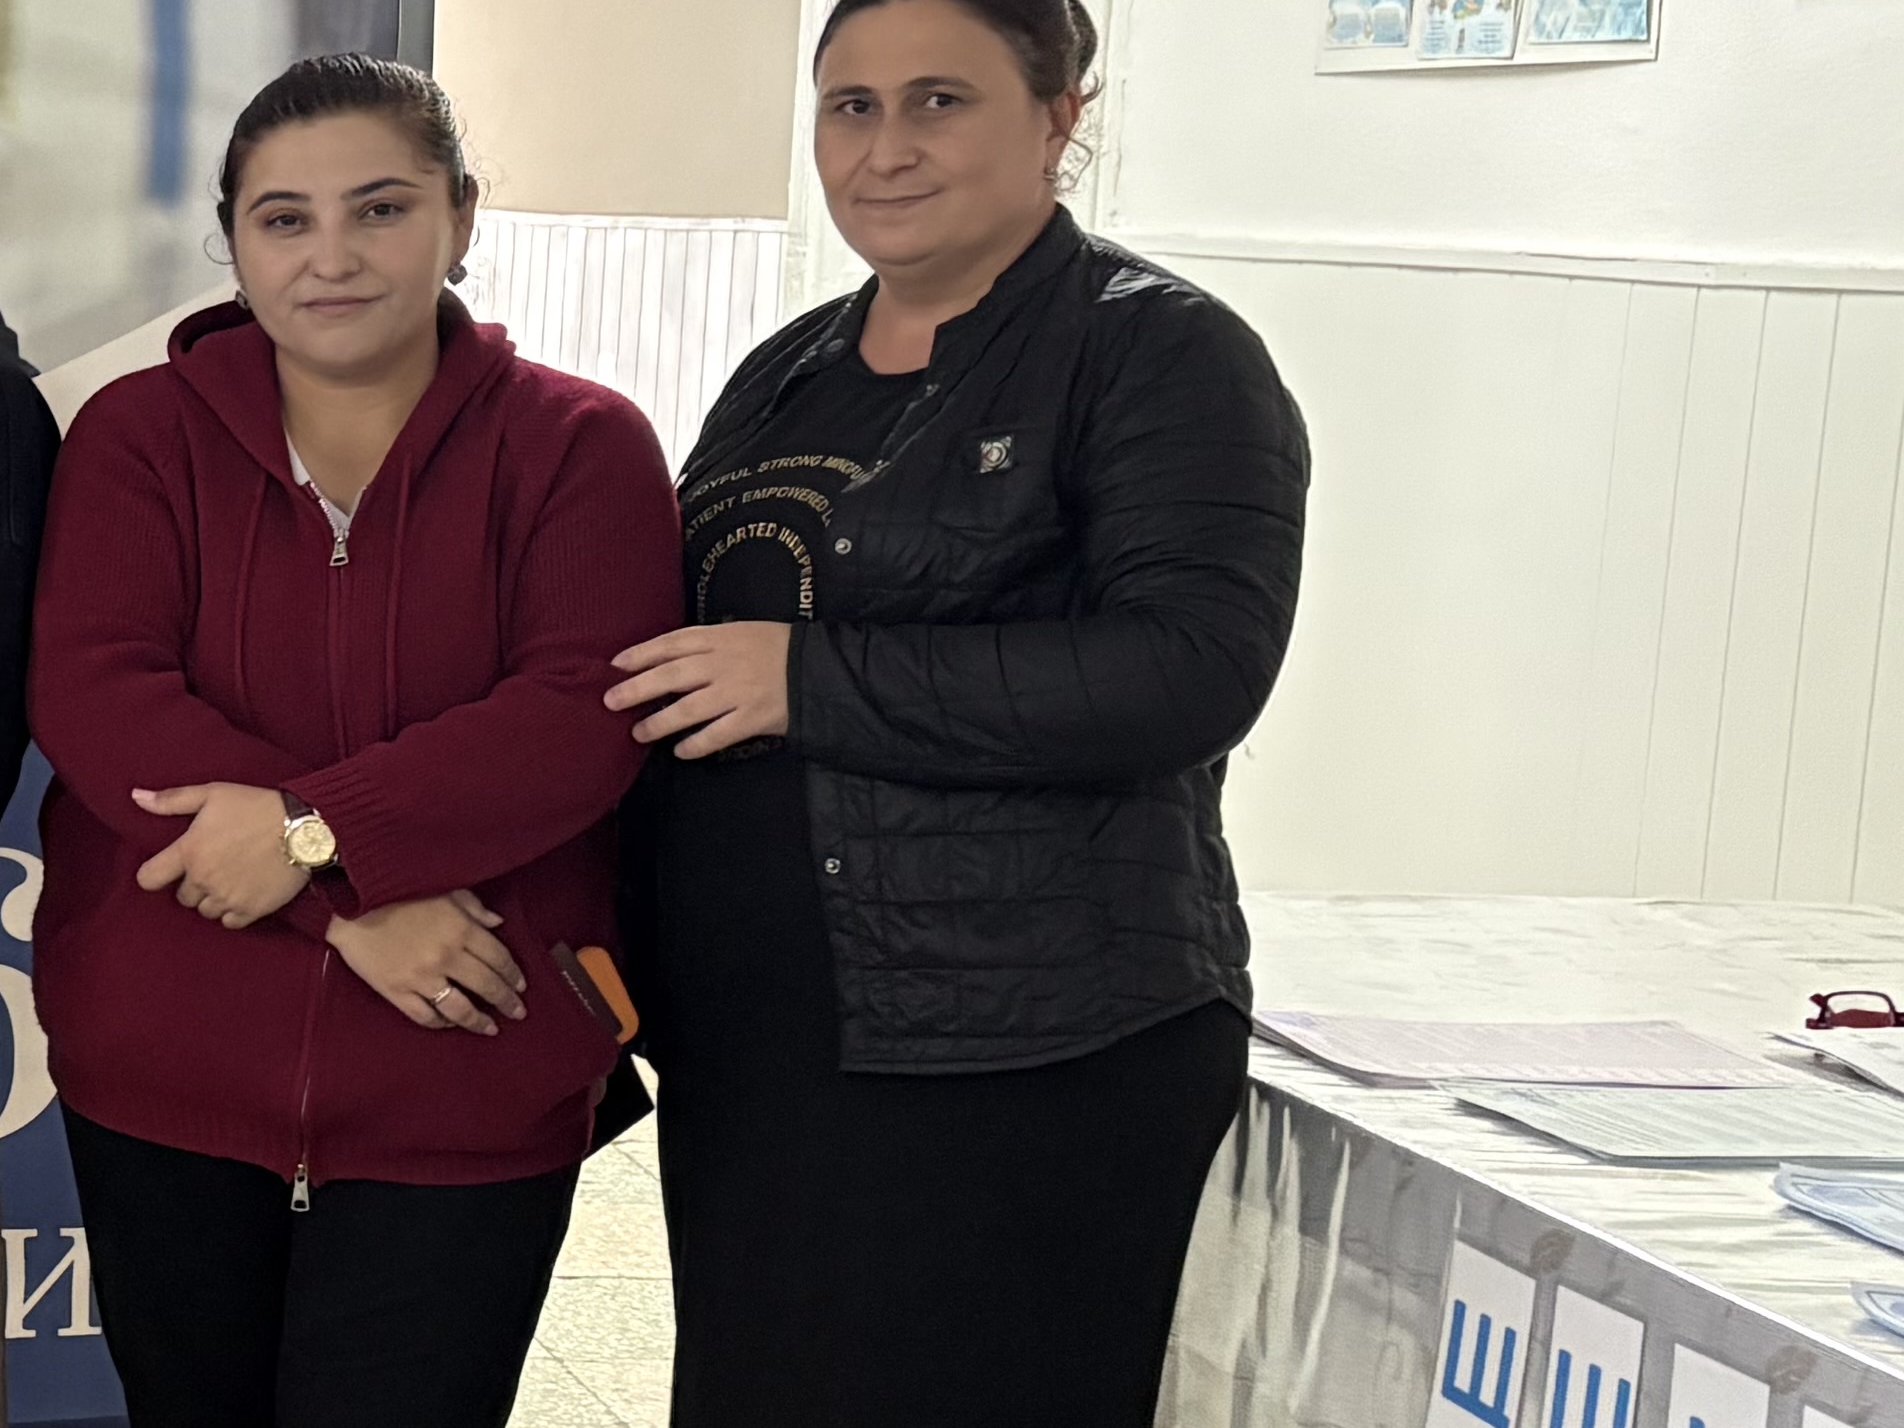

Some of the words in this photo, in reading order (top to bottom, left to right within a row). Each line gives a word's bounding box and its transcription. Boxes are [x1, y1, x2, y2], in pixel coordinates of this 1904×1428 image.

[757, 455, 823, 473] STRONG
[686, 495, 736, 540] ATIENT
[742, 486, 830, 513] EMPOWERED
